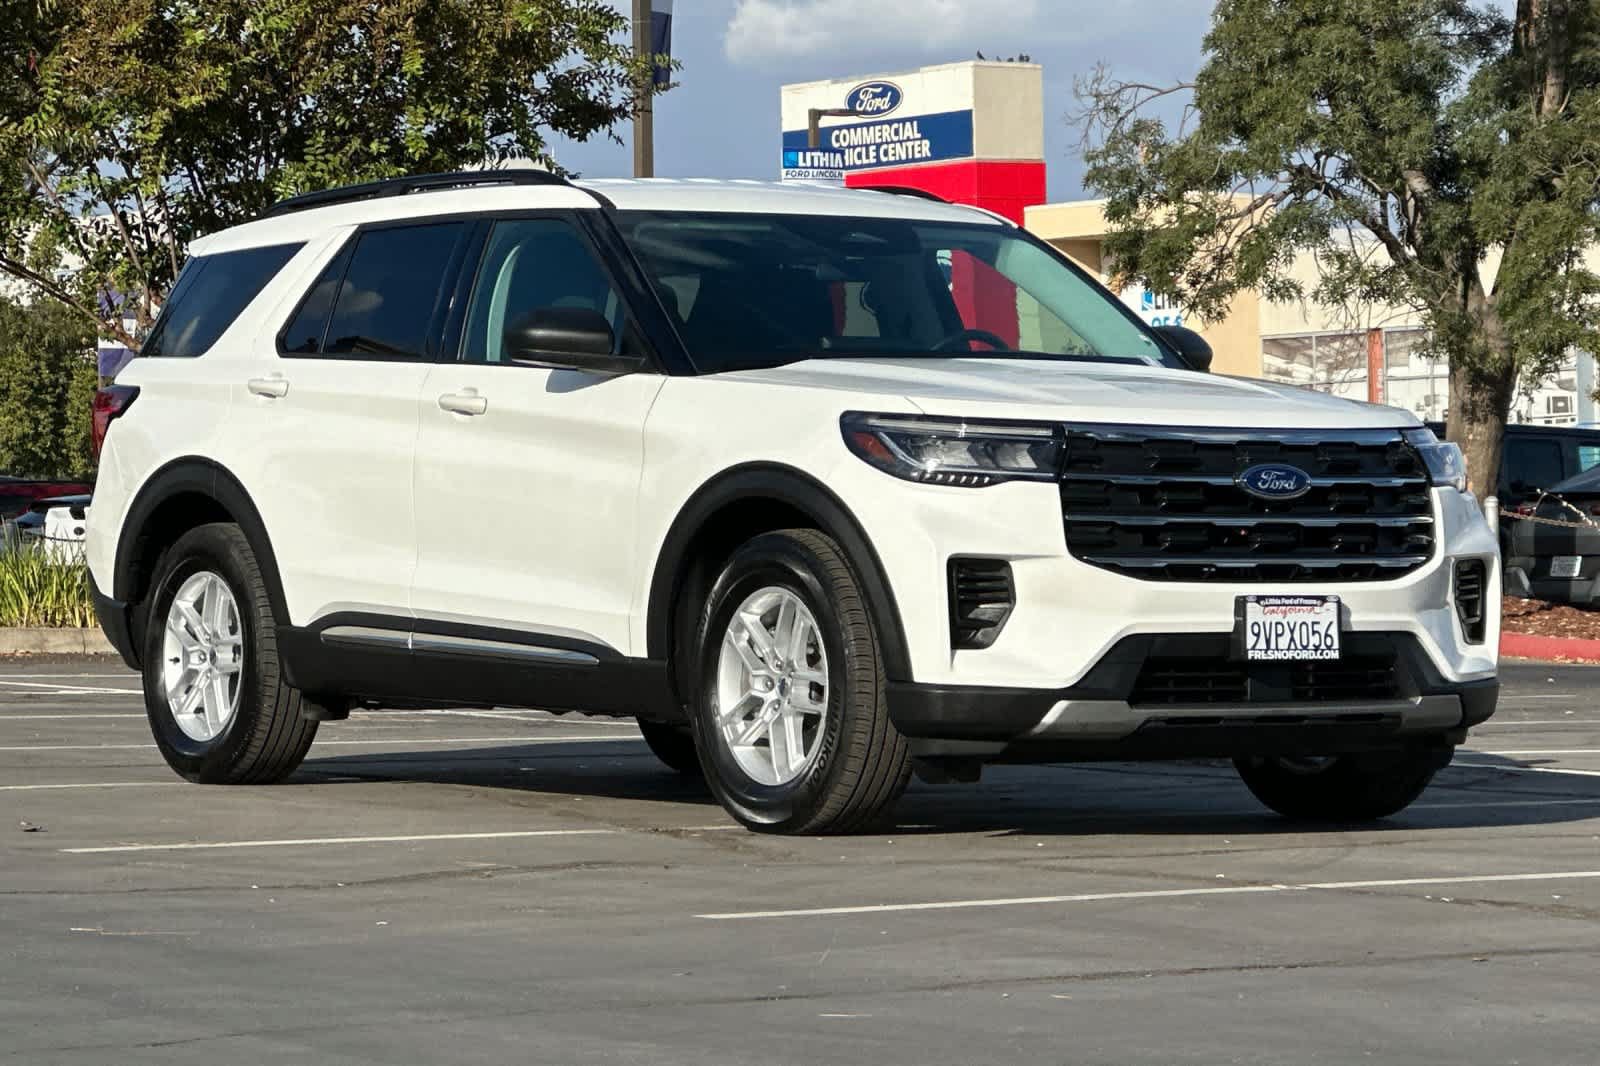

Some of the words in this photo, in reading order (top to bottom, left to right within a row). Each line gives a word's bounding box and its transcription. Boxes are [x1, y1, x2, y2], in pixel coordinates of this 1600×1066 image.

[855, 86, 892, 113] Ford
[831, 120, 922, 149] COMMERCIAL
[798, 151, 843, 168] LITHIA
[879, 139, 931, 162] CENTER
[785, 170, 811, 178] FORD
[811, 170, 843, 179] LINCOLN
[1257, 470, 1297, 490] Ford
[1251, 621, 1334, 650] 9VPX056
[1247, 649, 1340, 660] FRESNOFORD.COM
